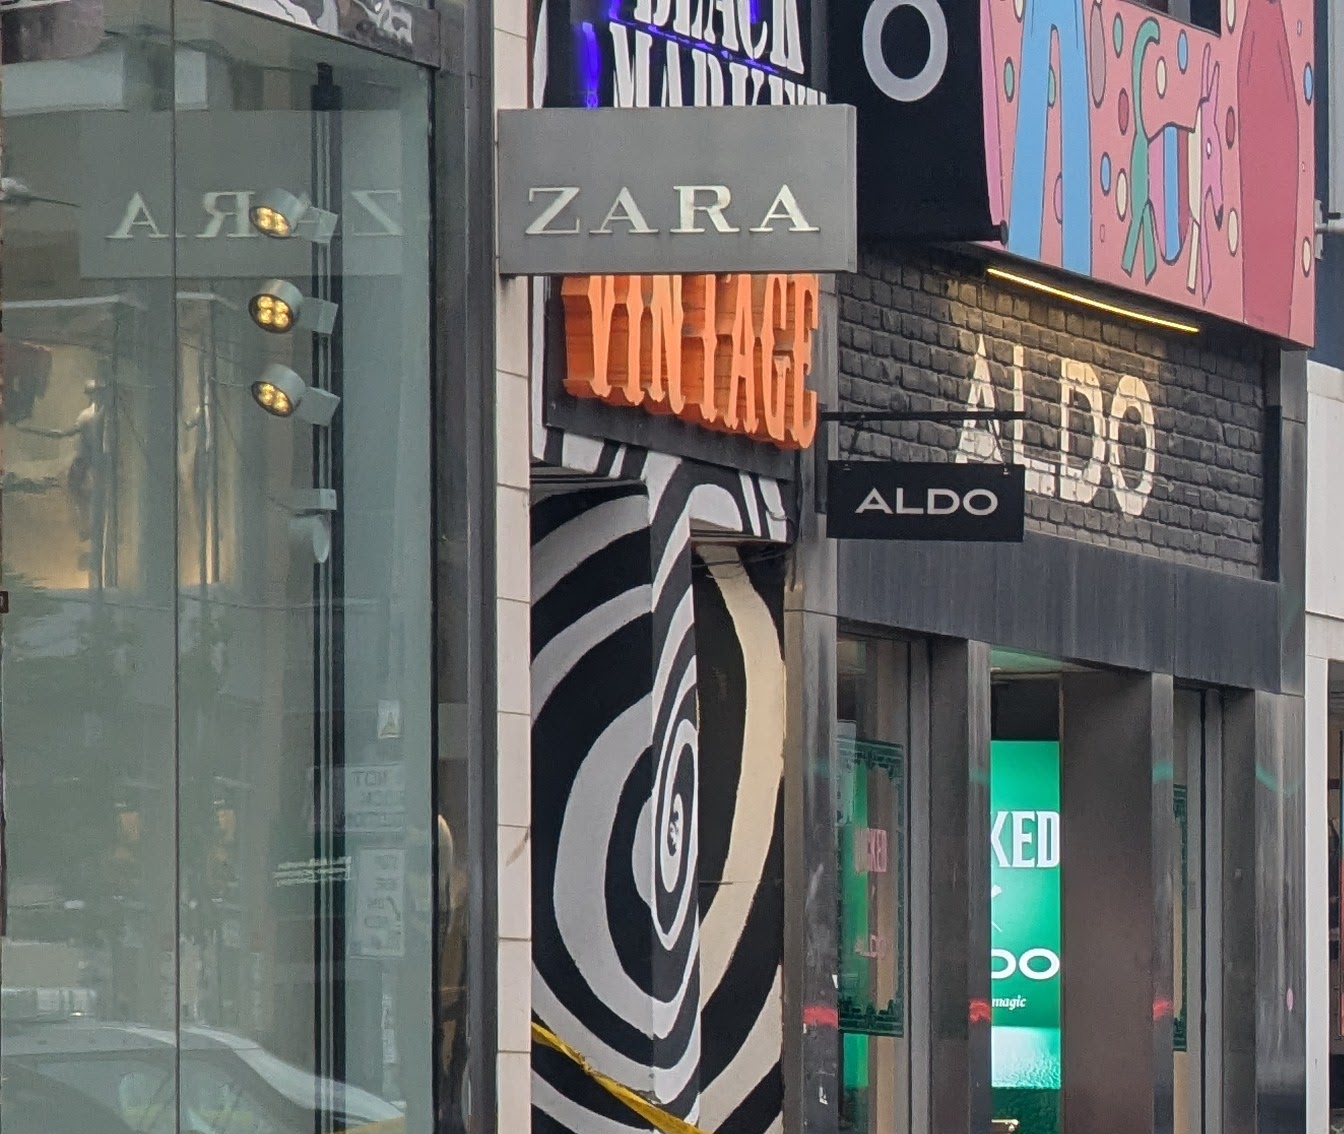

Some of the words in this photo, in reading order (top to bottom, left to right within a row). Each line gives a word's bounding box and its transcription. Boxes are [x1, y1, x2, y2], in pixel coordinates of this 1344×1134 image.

[525, 184, 821, 235] ZARA
[586, 275, 819, 448] VINTAGE
[955, 334, 1155, 516] ALDO
[854, 487, 998, 516] ALDO
[991, 995, 1027, 1011] magic
